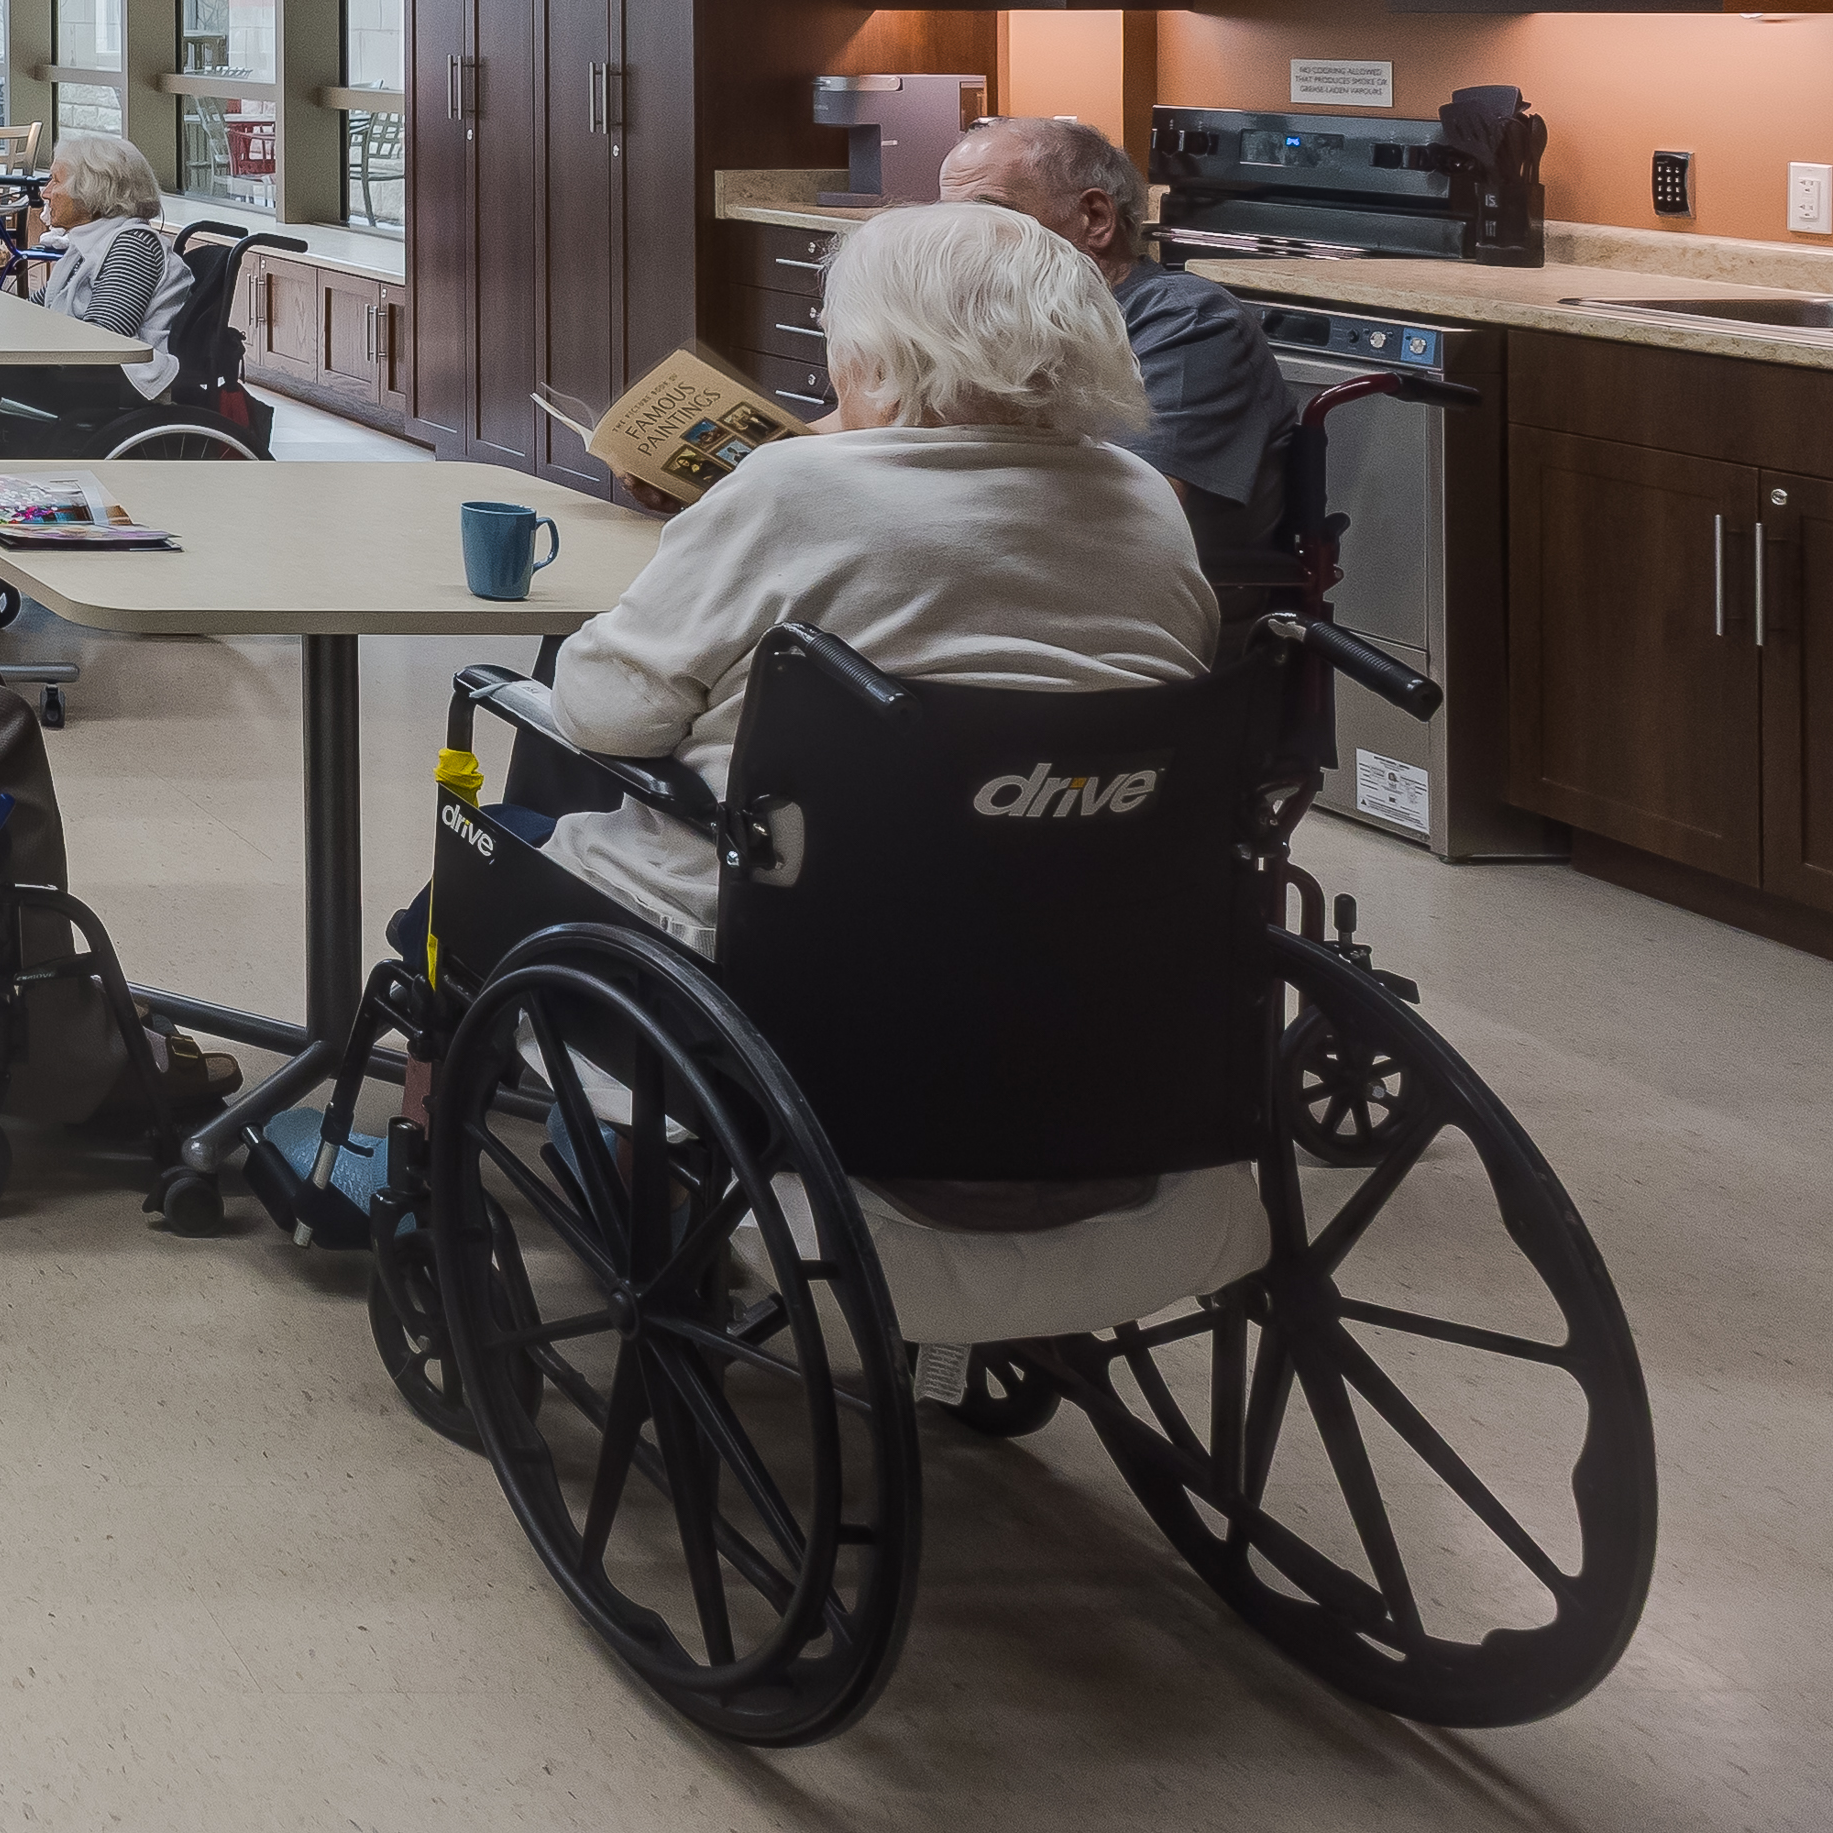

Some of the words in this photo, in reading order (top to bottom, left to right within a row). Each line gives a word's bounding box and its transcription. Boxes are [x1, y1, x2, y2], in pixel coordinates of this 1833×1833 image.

[624, 381, 696, 440] FAMOUS
[637, 388, 721, 457] PAINTINGS
[973, 763, 1157, 817] drive
[442, 804, 493, 856] drive
